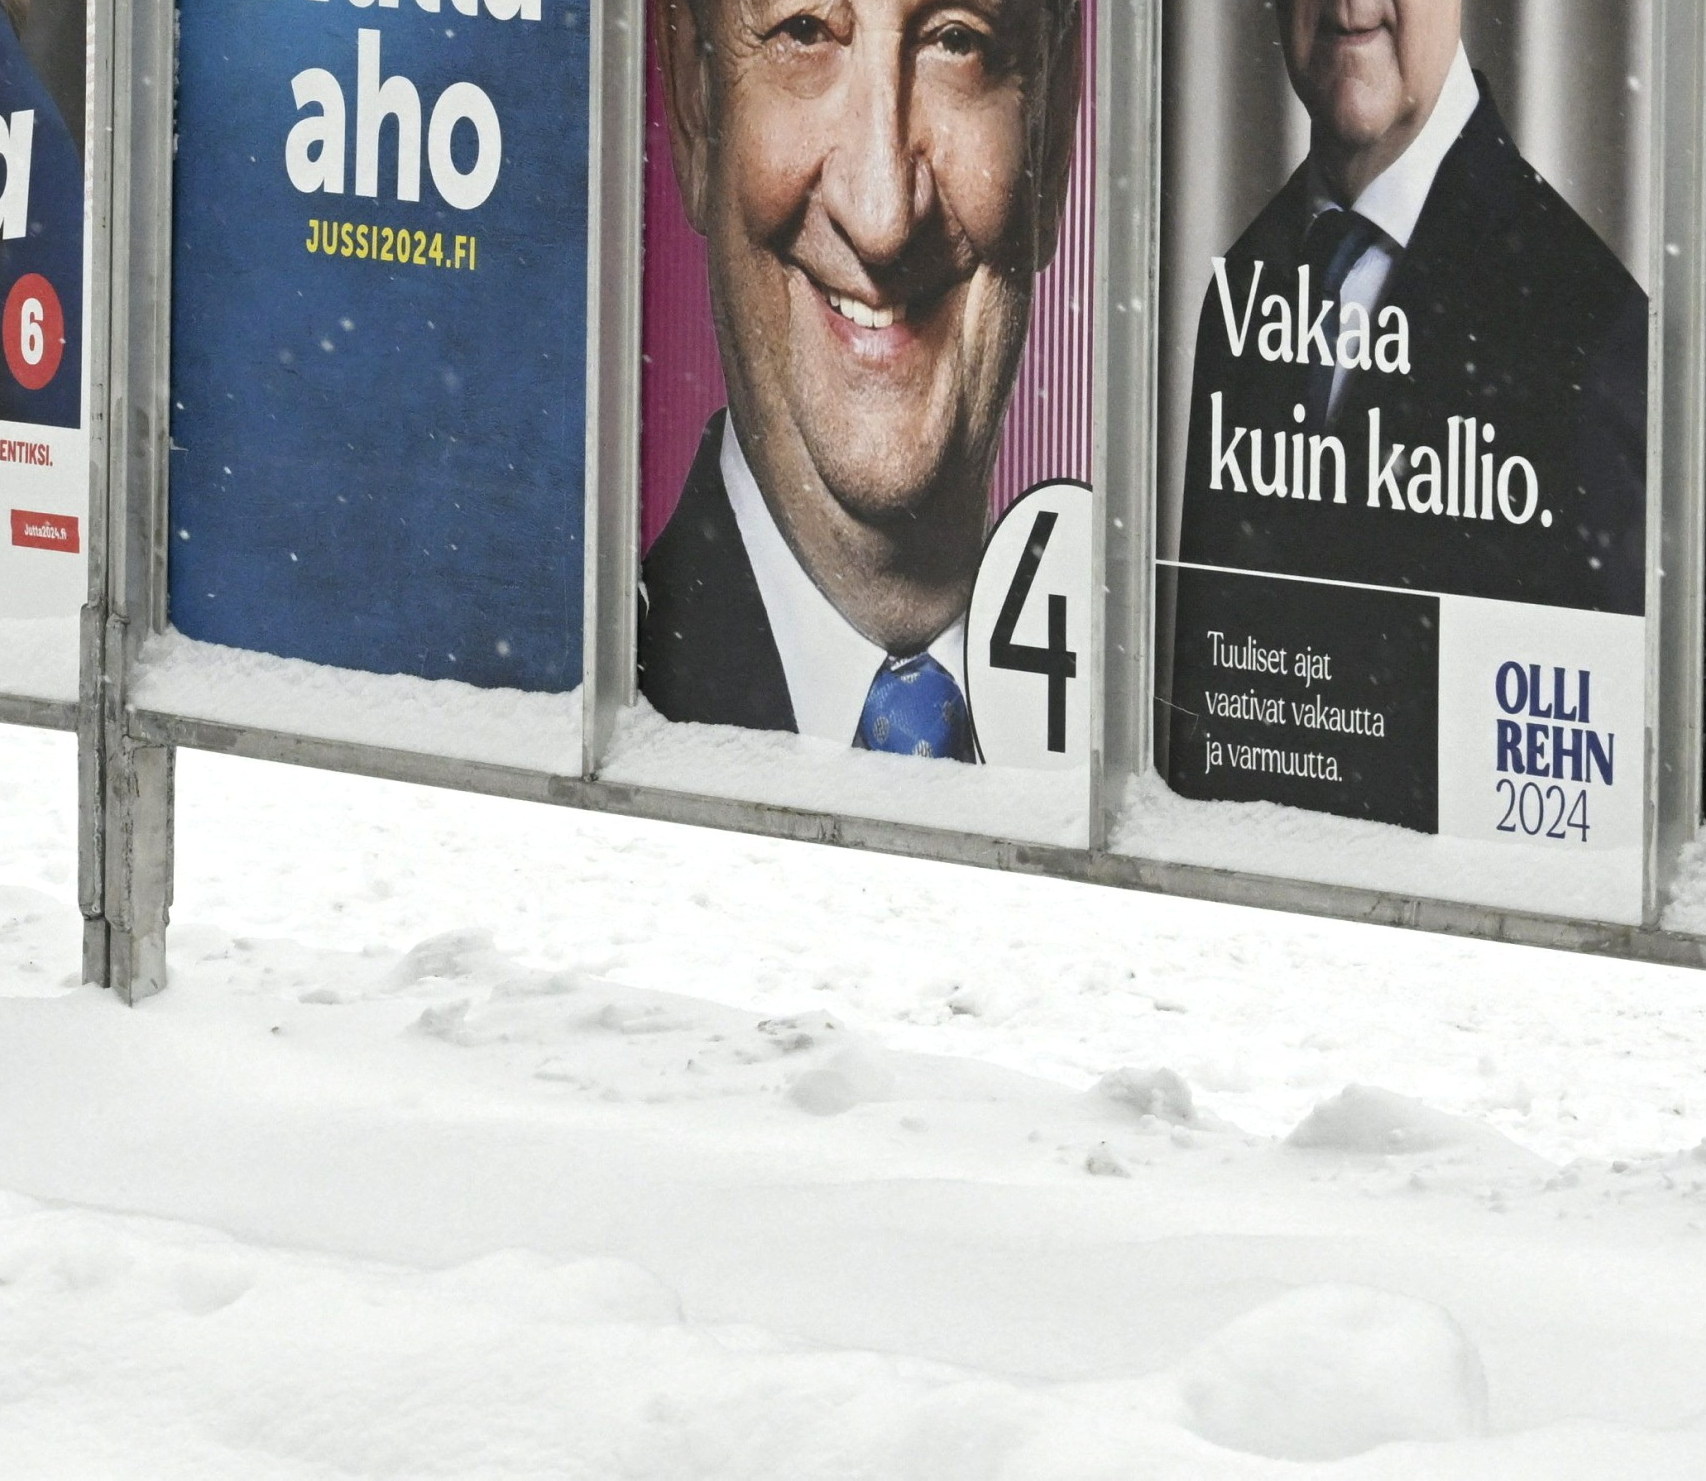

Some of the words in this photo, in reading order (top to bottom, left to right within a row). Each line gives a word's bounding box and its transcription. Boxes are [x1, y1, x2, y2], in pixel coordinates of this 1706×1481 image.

[285, 27, 503, 211] aho
[306, 219, 477, 271] JUSSI2024.FI
[20, 297, 44, 365] 6
[1210, 256, 1411, 375] Vakaa
[1209, 391, 1347, 504] kuin
[1367, 406, 1553, 528] kallio.
[24, 523, 67, 540] Jutta2024.fi
[989, 510, 1077, 754] 4
[1207, 630, 1288, 675] Tuuliset
[1294, 646, 1332, 688] ajat
[1205, 688, 1286, 725] vaativat
[1291, 694, 1385, 738] vakautta
[1495, 660, 1590, 723] OLLI
[1205, 732, 1223, 774] ja
[1227, 743, 1343, 782] varmuutta.
[1496, 718, 1615, 786] REHN
[1496, 778, 1590, 842] 2024
